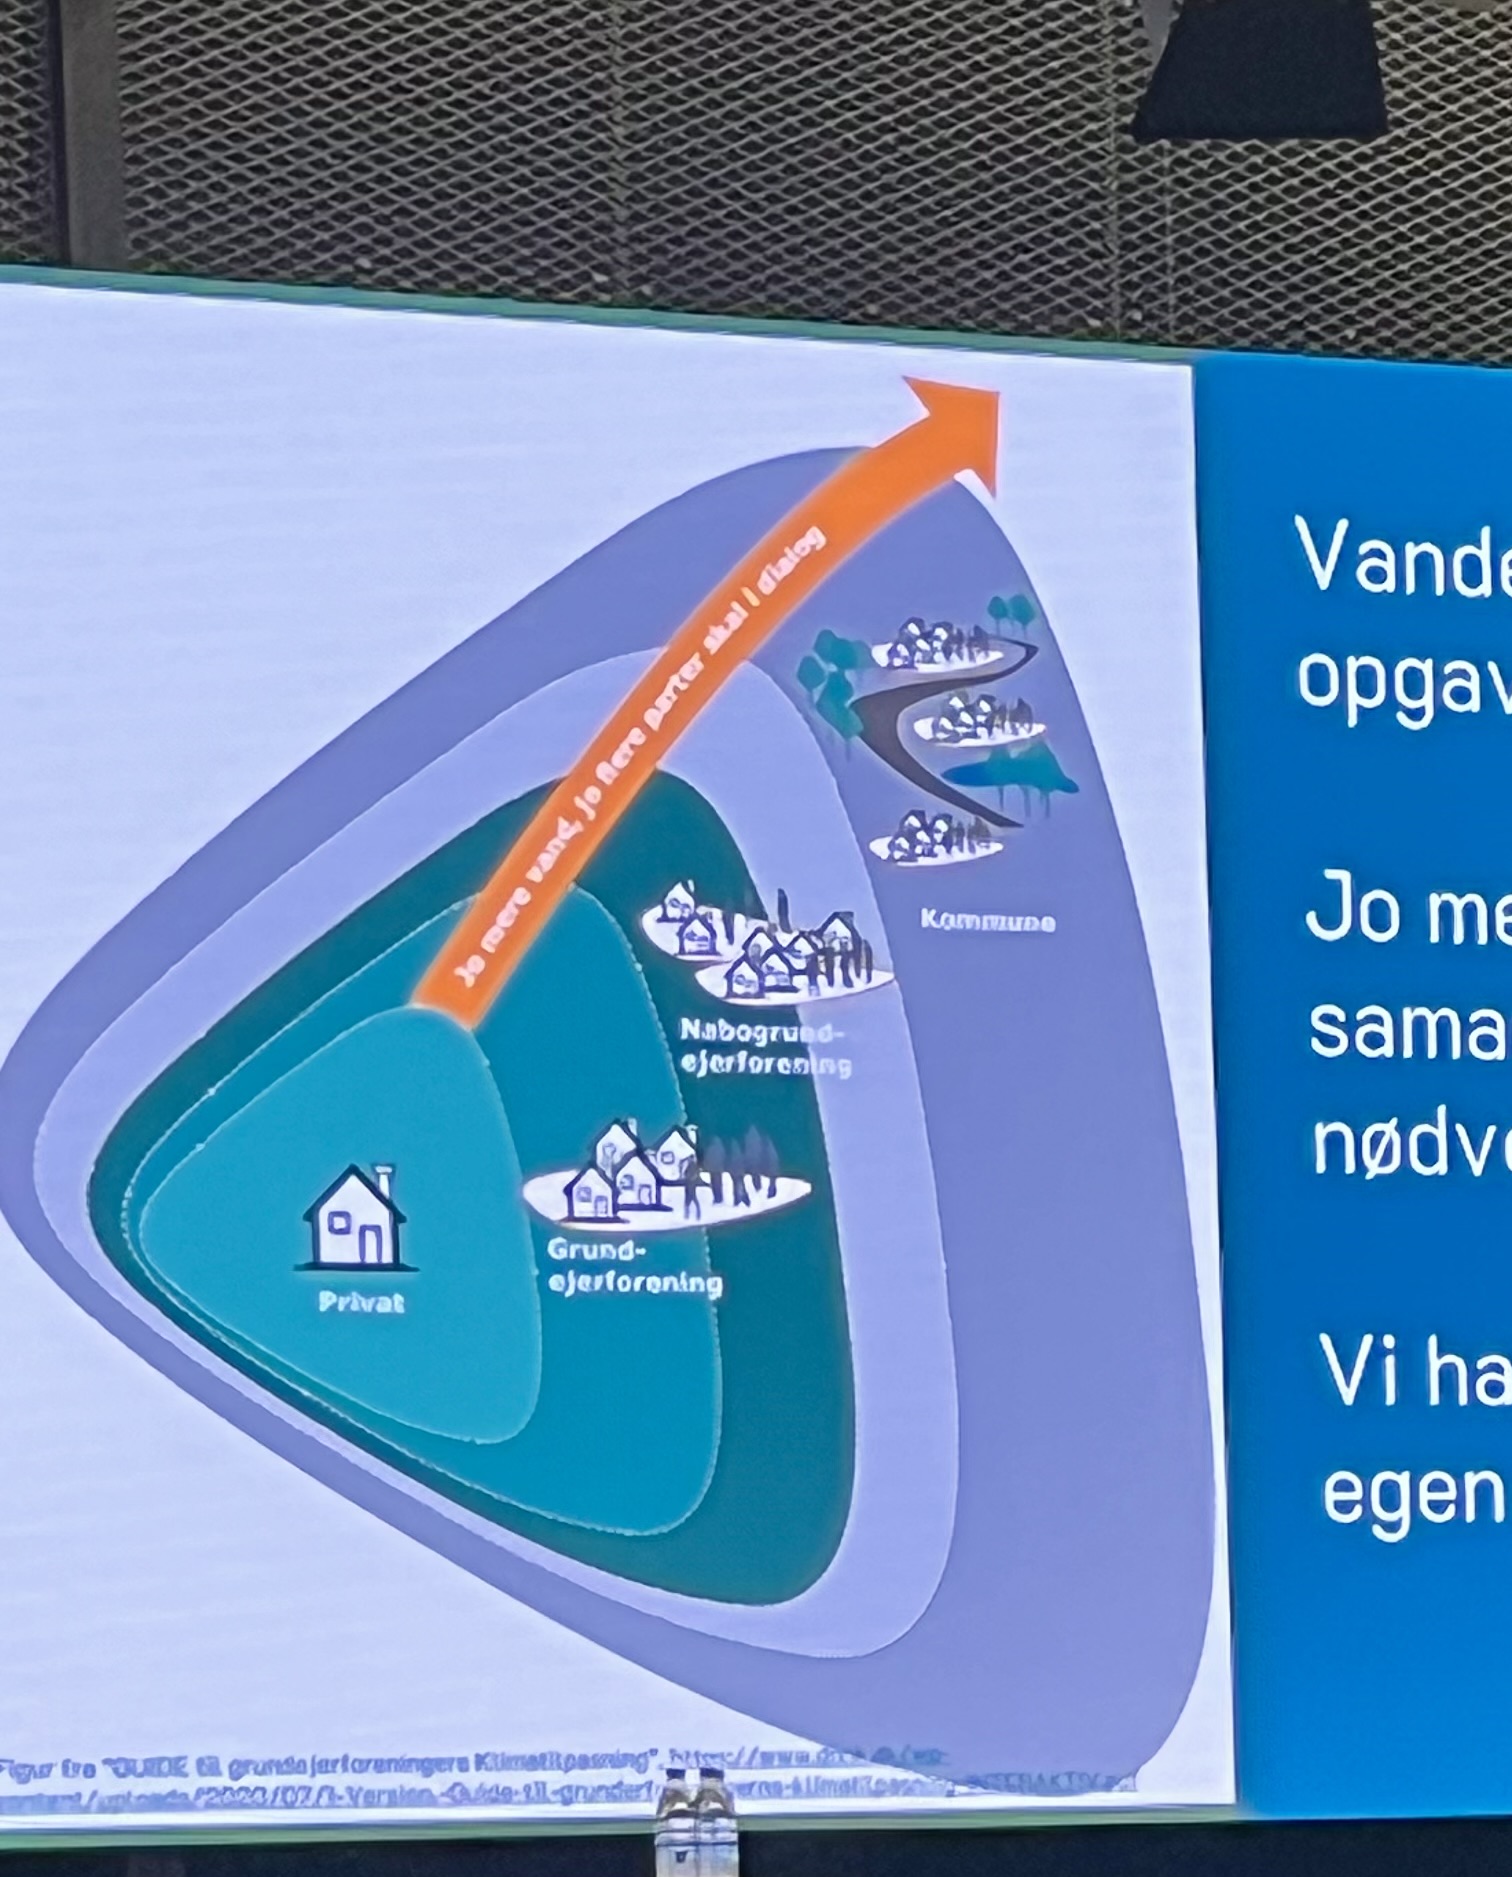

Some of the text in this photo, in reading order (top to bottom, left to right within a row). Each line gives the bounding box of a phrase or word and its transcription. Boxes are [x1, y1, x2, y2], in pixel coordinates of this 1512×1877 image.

[920, 907, 1057, 934] Kommune
[1305, 868, 1400, 943] Jo
[547, 1237, 647, 1261] Grund-
[548, 1269, 724, 1299] ejerforening
[318, 1290, 405, 1314] Privat
[1319, 1332, 1396, 1406] Vi
[1324, 1470, 1505, 1543] egen
